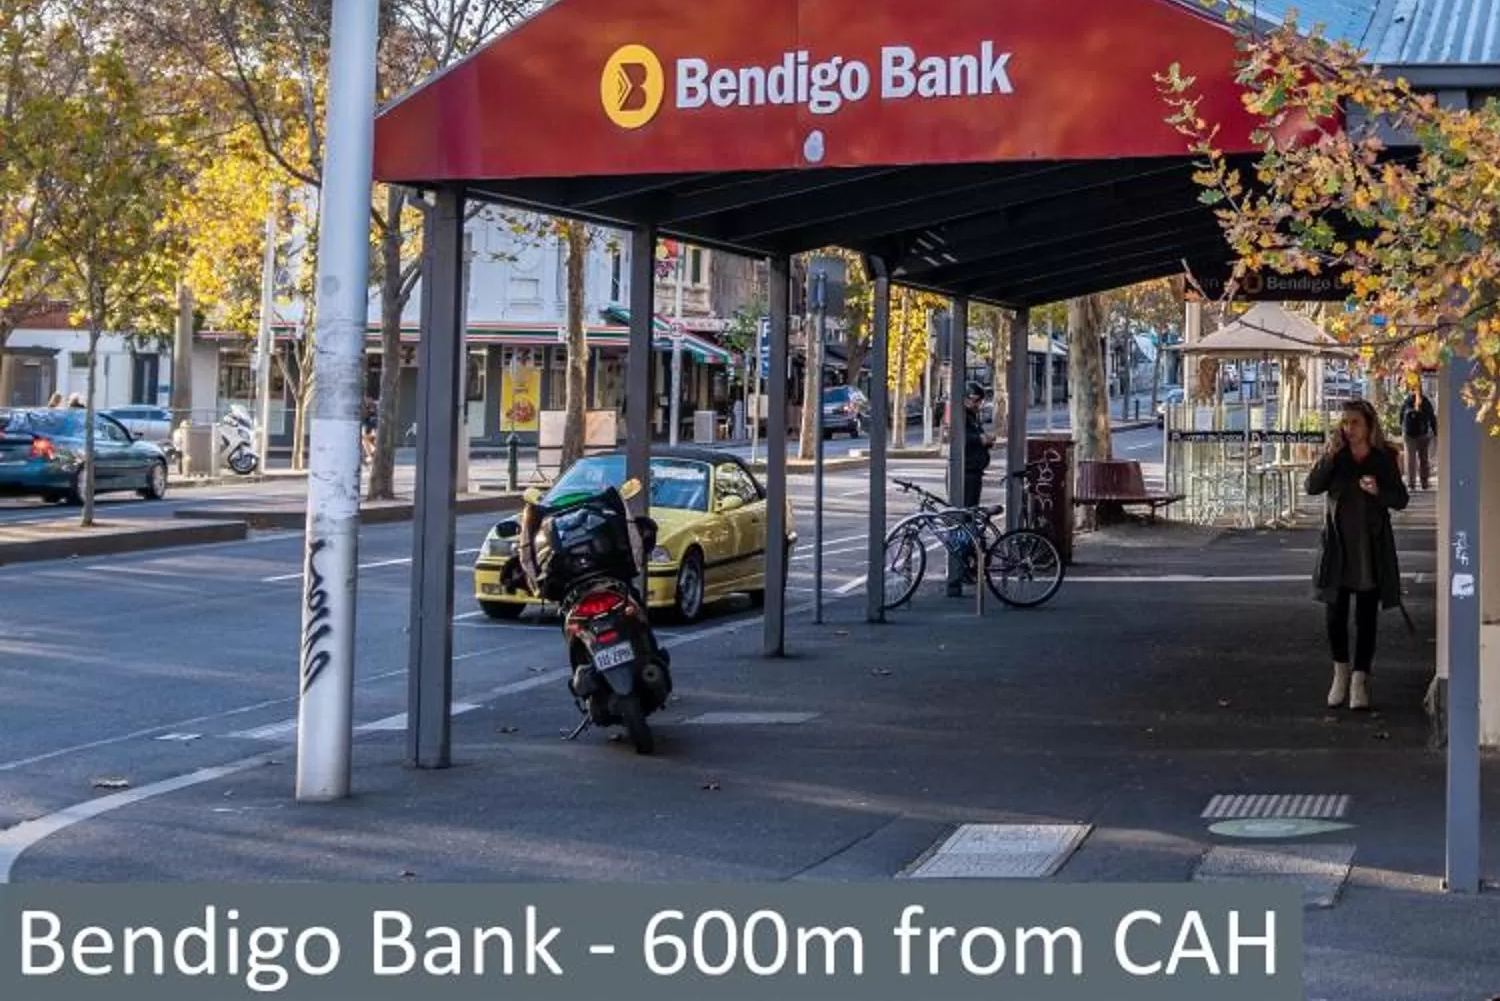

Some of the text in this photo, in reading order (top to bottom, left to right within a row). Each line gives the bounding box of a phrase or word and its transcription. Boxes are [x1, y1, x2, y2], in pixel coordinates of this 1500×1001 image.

[675, 52, 869, 114] Bendigo
[881, 40, 1013, 99] Bank
[1265, 276, 1330, 293] Bendigo
